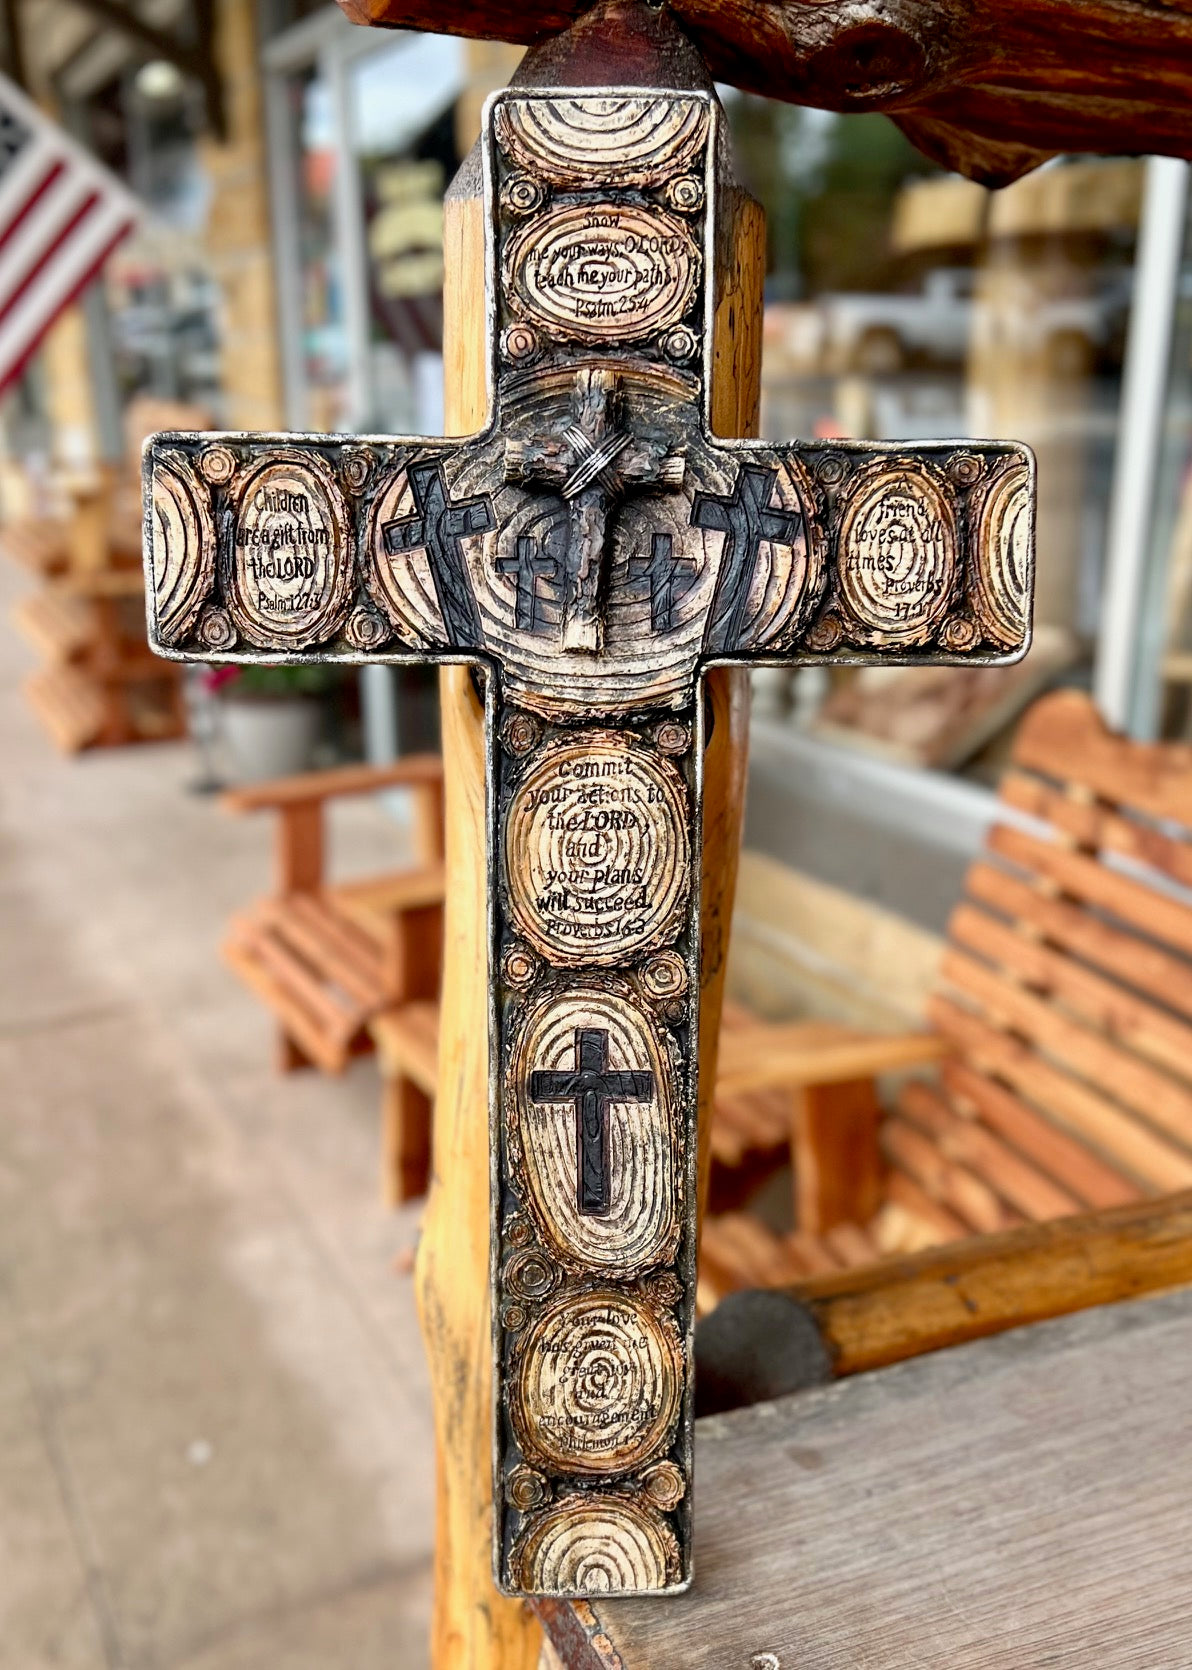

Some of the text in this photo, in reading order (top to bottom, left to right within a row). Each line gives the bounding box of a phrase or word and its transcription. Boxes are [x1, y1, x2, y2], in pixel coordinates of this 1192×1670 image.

[528, 247, 549, 261] me
[552, 244, 584, 264] your
[624, 235, 637, 254] O
[534, 264, 677, 290] teach me your paths.
[574, 295, 650, 319] Psalm 25:4
[896, 472, 913, 493] A
[253, 486, 310, 513] Children
[876, 496, 927, 524] friend
[236, 521, 330, 550] are a gift from
[853, 520, 943, 544] loves at all
[247, 556, 316, 581] the LORD
[882, 569, 944, 596] Proverbs
[257, 591, 321, 611] Psalm 127:3
[524, 782, 666, 813] your actions to
[547, 806, 579, 831] the
[564, 834, 600, 859] and
[543, 865, 644, 894] your plans
[535, 888, 571, 913] will
[606, 1308, 638, 1326] love
[540, 1337, 571, 1354] has
[575, 1383, 609, 1401] and
[538, 1406, 658, 1428] encouragement
